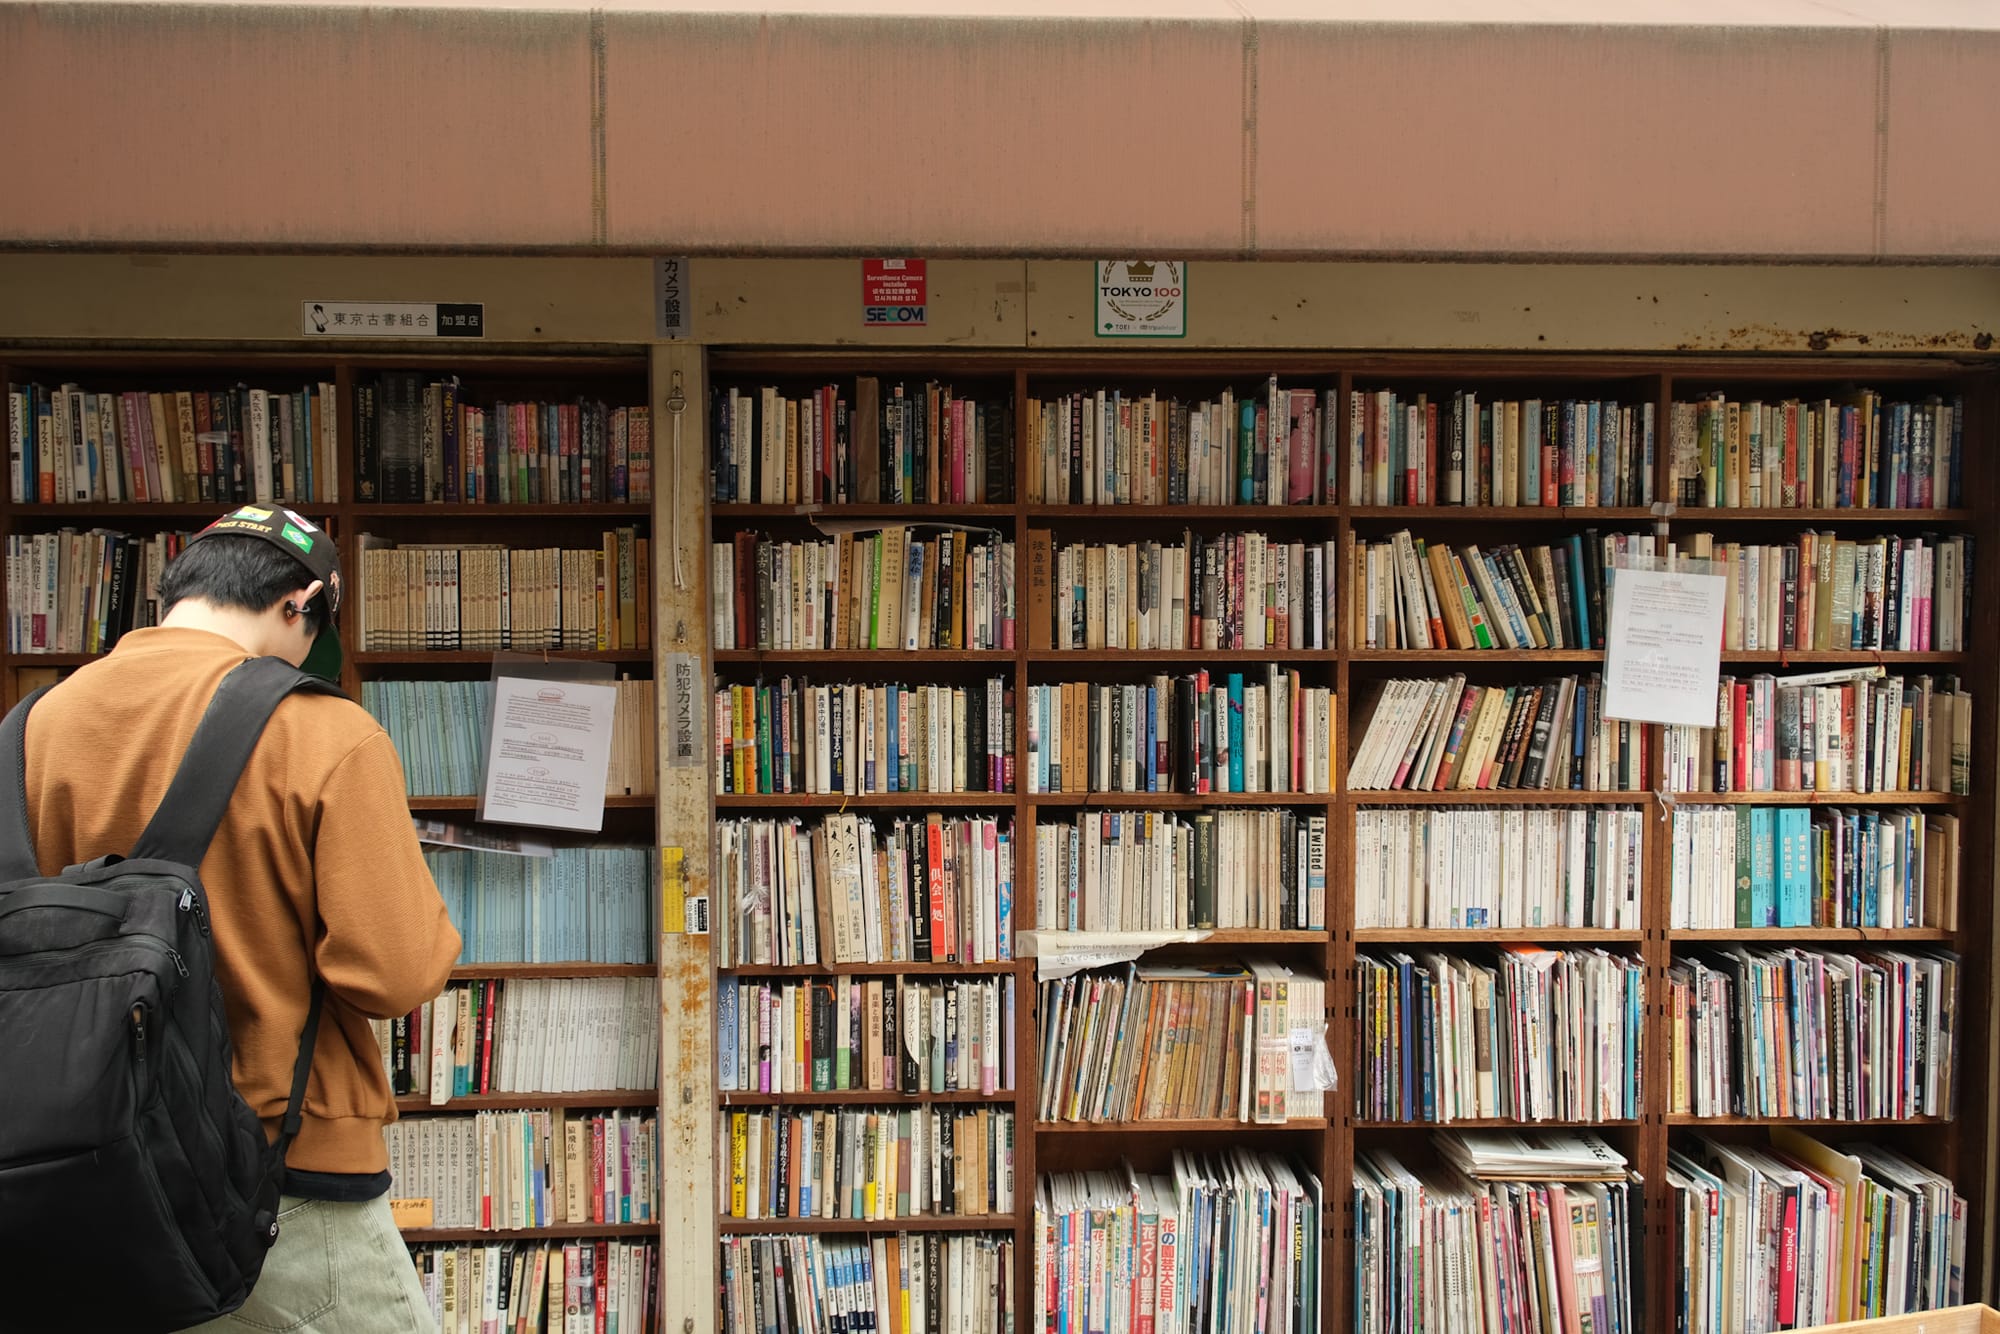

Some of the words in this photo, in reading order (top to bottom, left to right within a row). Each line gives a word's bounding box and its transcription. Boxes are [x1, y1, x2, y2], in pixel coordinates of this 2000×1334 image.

[665, 259, 681, 328] カメラ設置
[1101, 287, 1151, 297] TOKYO
[1154, 287, 1181, 297] 100
[334, 312, 431, 328] 東京古書組合
[441, 315, 479, 328] 加盟店
[867, 307, 923, 322] SECOM
[676, 663, 693, 757] 防犯カメラ設置
[1311, 827, 1324, 870] Twisted
[931, 868, 944, 922] 倶会一処
